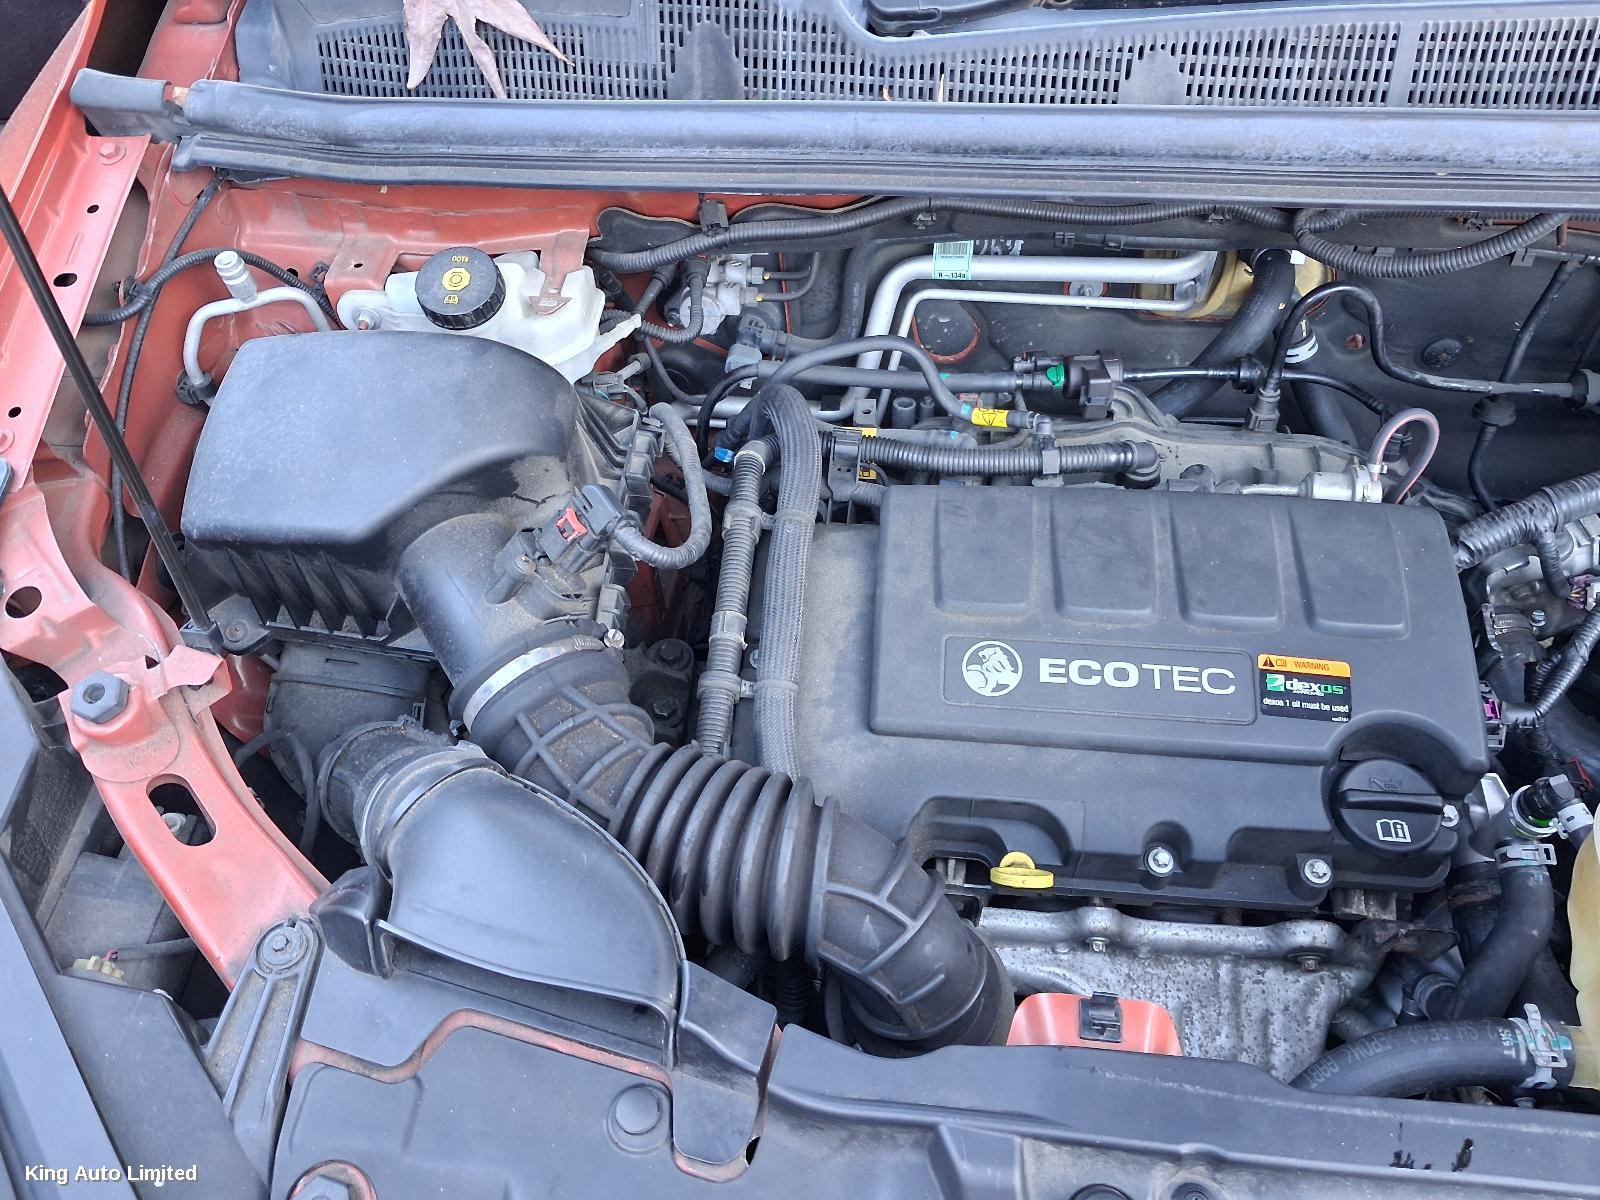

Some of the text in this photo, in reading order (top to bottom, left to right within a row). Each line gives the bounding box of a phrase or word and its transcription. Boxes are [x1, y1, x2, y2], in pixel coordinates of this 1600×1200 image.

[1294, 661, 1329, 671] WARNING
[1039, 657, 1236, 695] ECOTEC
[1285, 678, 1344, 694] dexos
[1262, 698, 1349, 712] dexos 1 oil must be used
